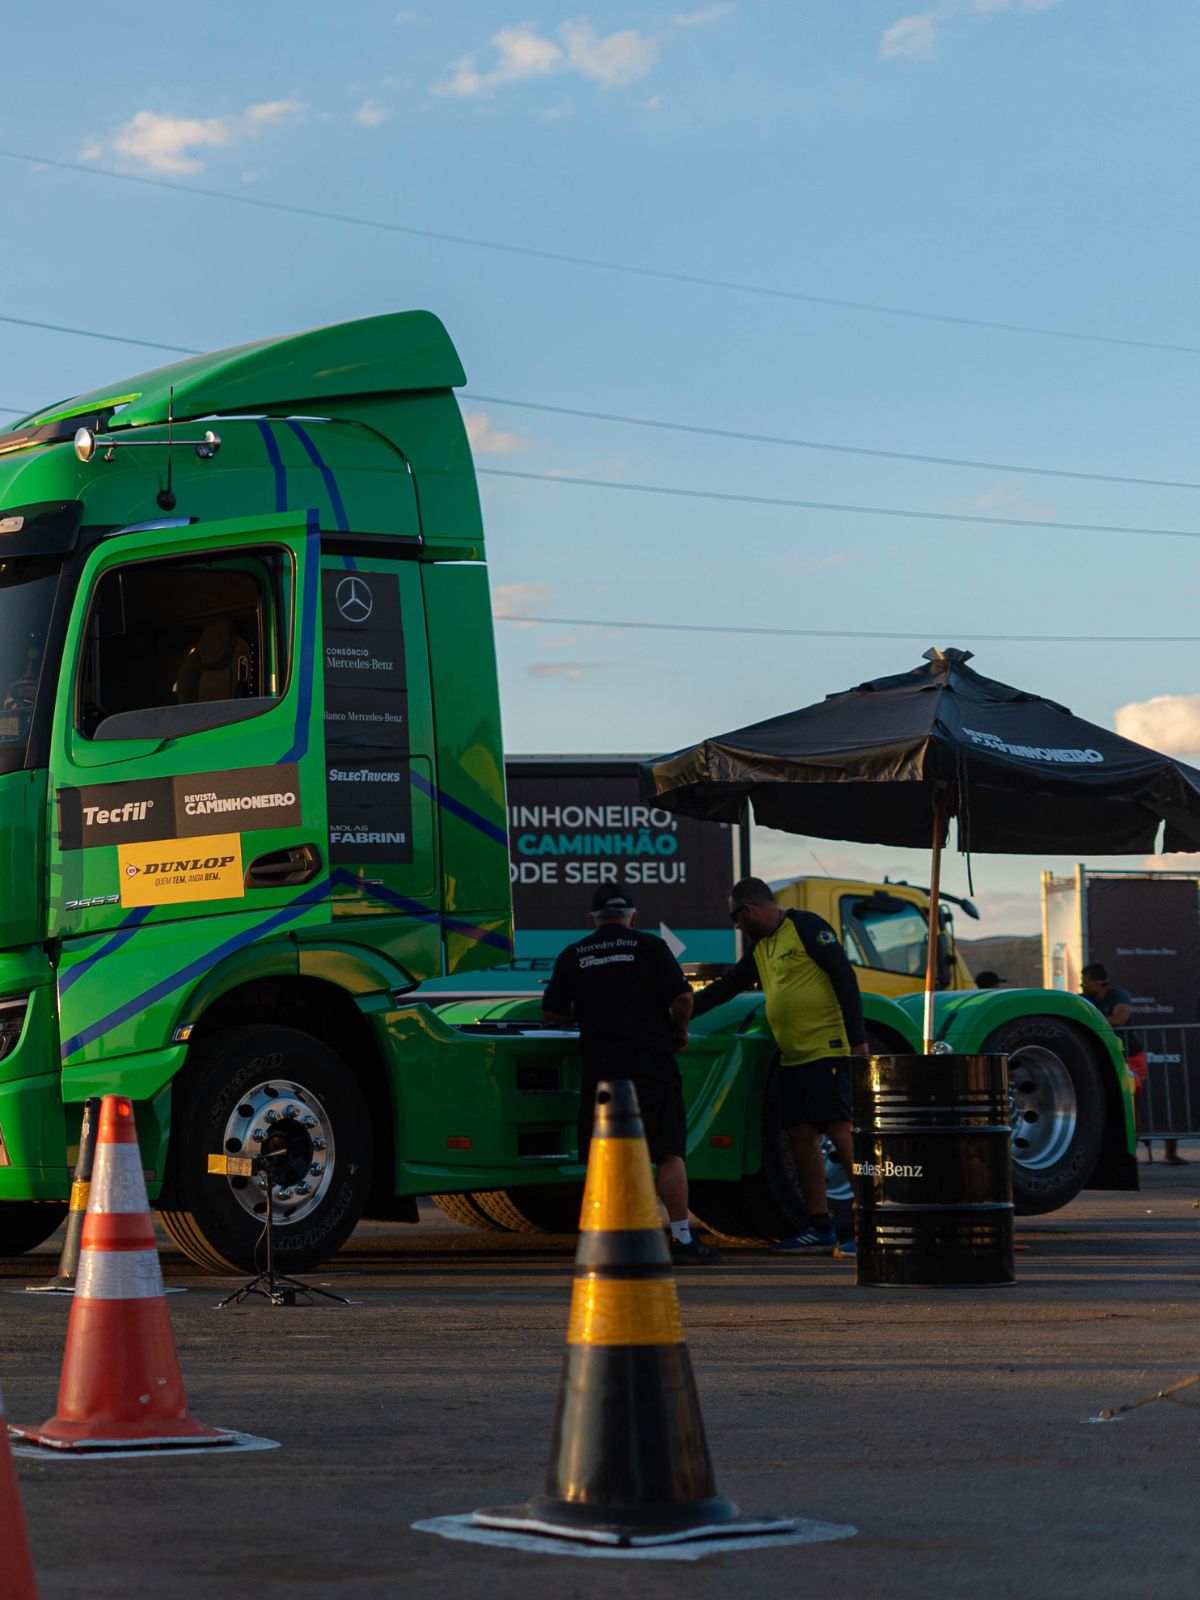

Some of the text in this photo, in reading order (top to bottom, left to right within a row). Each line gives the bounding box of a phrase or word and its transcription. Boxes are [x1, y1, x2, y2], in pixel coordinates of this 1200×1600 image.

[326, 646, 369, 656] CONSÓRCIO
[327, 657, 394, 671] Mercedes-Benz
[324, 711, 403, 723] Banco Mercedes-Benz
[184, 793, 217, 803] REVISTA
[185, 792, 296, 816] CAMINHONEIRO
[508, 805, 678, 831] INHONEIRO,
[330, 832, 406, 844] FABRINI
[517, 829, 678, 856] CAMINHÃO
[143, 856, 235, 875] DUNLOP
[564, 862, 618, 884] SER
[624, 862, 687, 884] SEU!
[576, 938, 638, 953] Mercedes-Benz
